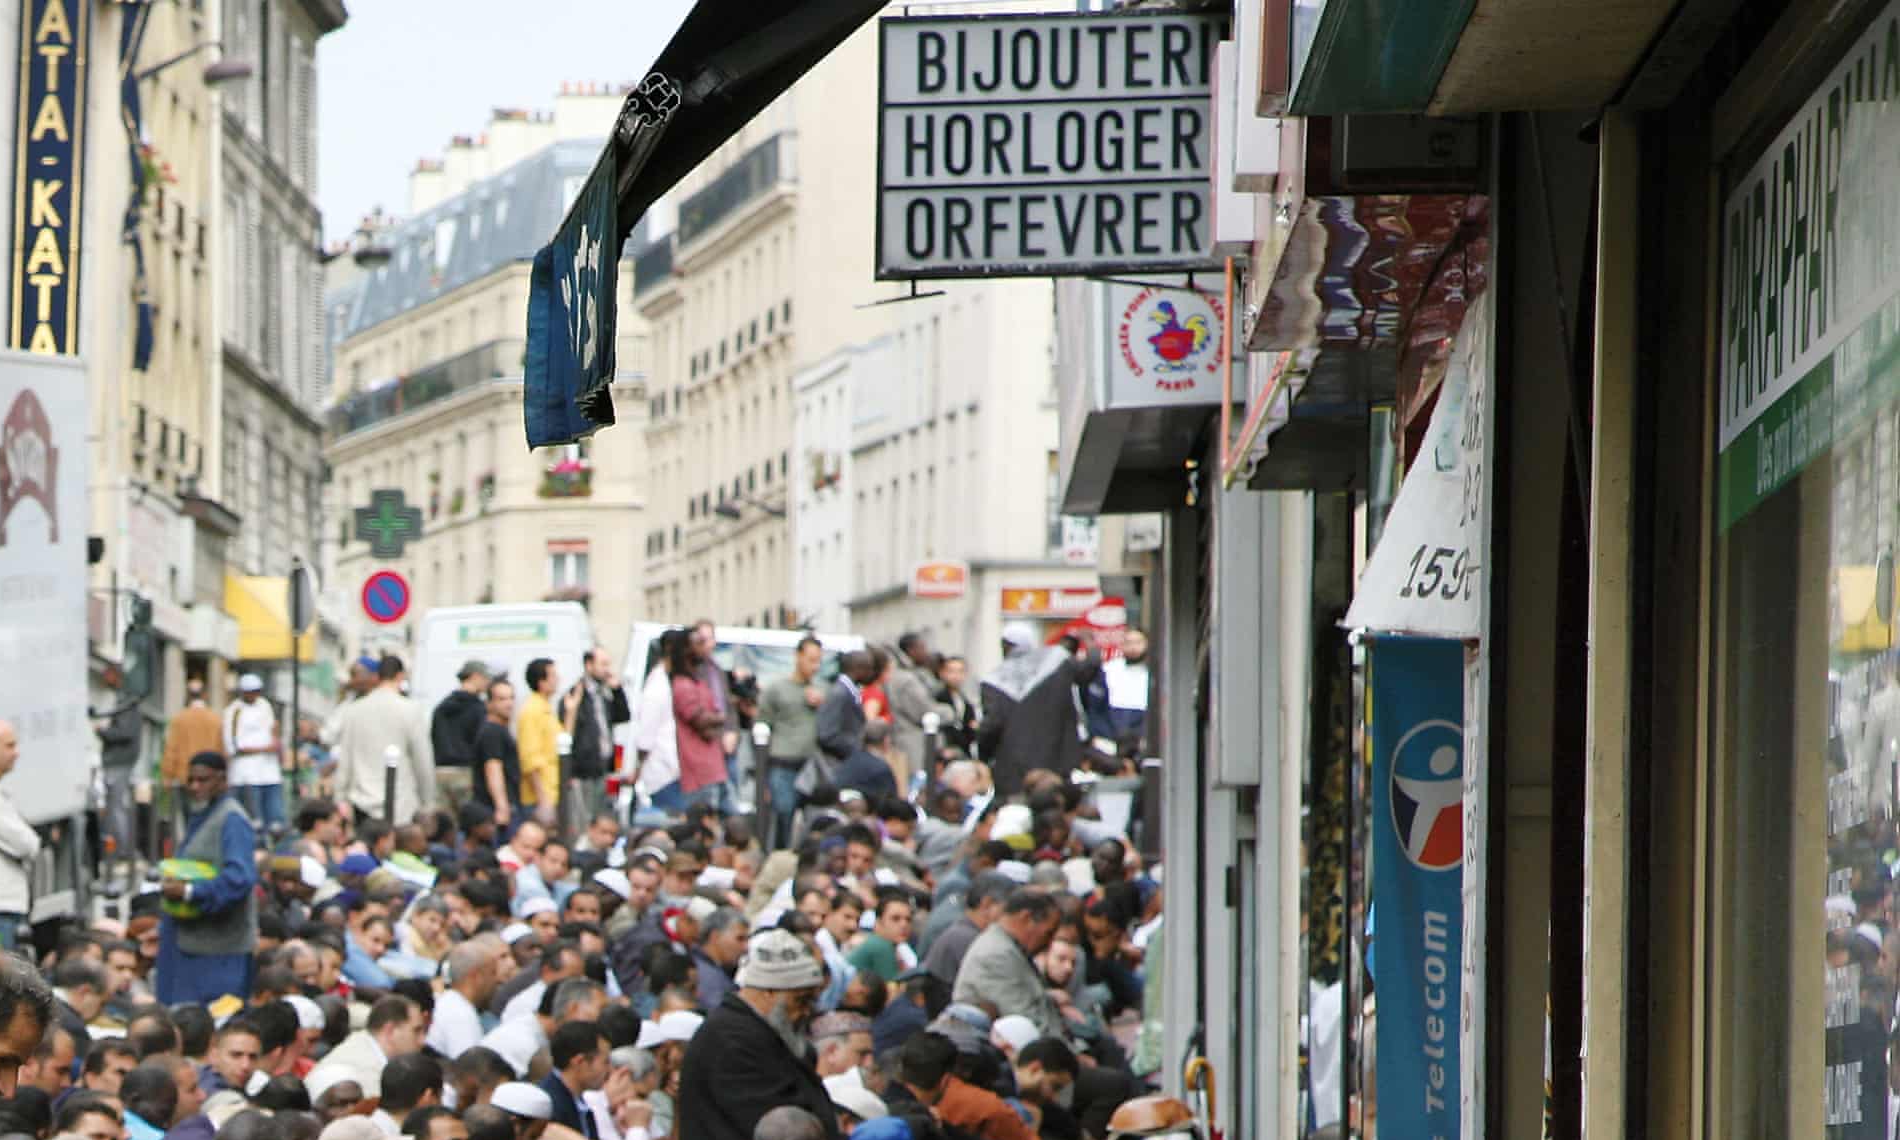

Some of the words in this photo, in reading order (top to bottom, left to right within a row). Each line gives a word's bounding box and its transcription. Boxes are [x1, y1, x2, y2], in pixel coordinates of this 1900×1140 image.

[904, 104, 1202, 178] HORLOGER
[905, 188, 1202, 261] ORFEVRER
[1423, 910, 1448, 1115] Telecom
